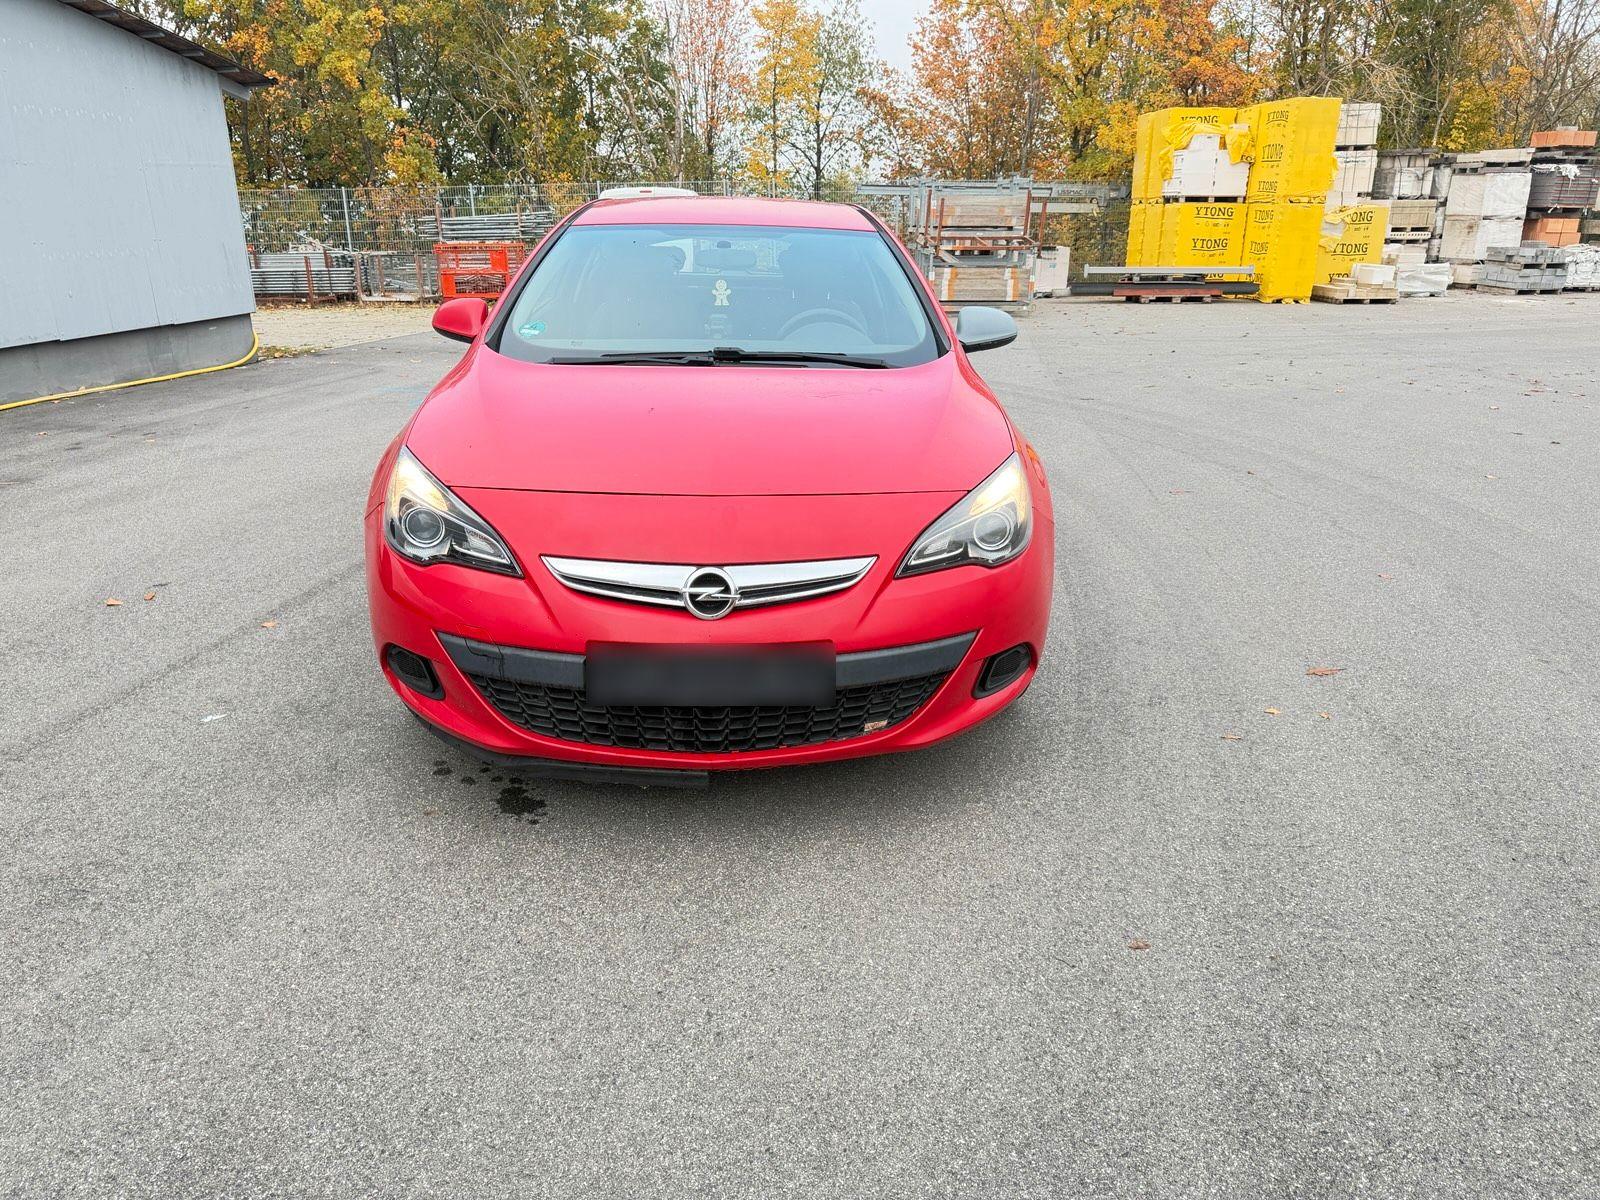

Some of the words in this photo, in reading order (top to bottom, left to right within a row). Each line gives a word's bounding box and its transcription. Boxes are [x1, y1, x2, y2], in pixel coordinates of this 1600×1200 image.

[1181, 115, 1219, 124] ONG
[1267, 110, 1289, 121] YTONG
[1262, 144, 1283, 160] YTONG
[1258, 180, 1278, 191] YTONG
[1195, 206, 1234, 217] YTONG
[1254, 209, 1274, 221] YTONG
[1346, 211, 1374, 223] ONG
[1192, 238, 1228, 249] YTONG
[1250, 241, 1268, 252] YTONG
